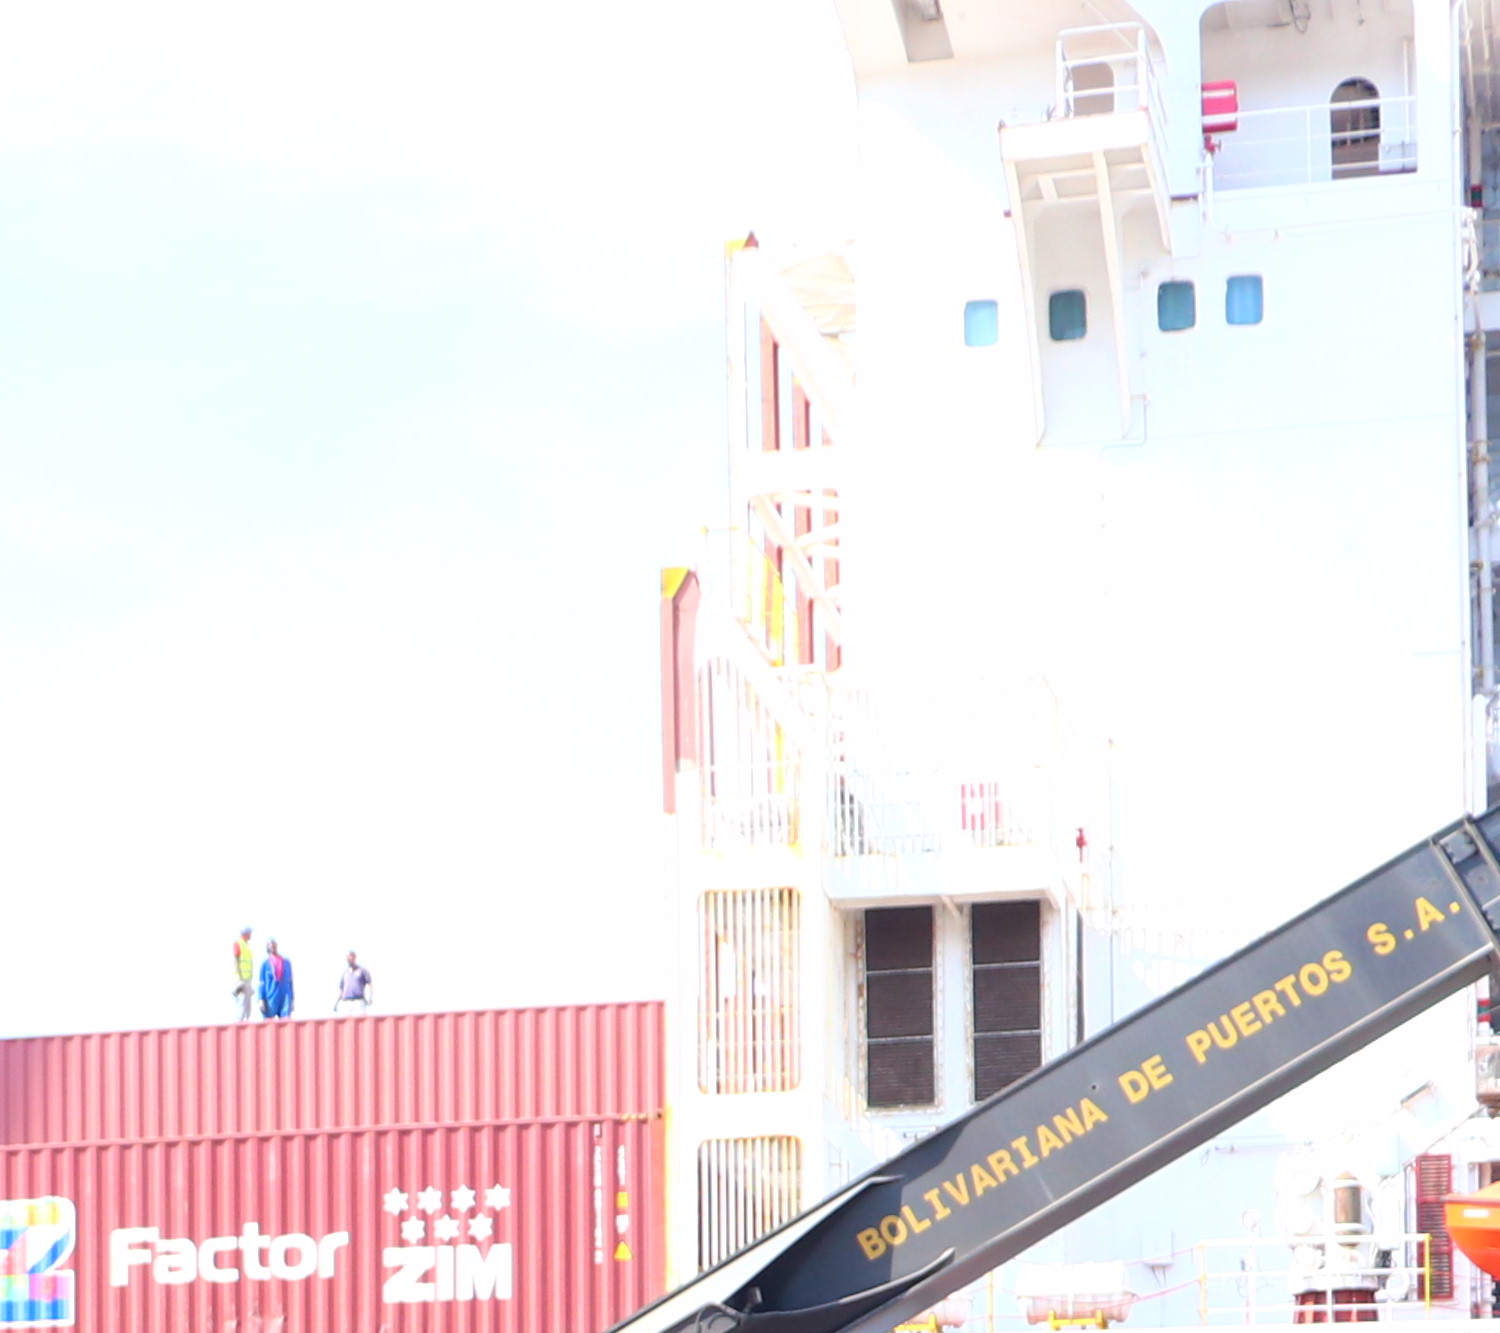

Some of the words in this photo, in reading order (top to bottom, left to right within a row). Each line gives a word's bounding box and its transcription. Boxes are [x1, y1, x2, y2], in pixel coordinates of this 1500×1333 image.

[856, 1097, 1109, 1261] BOLIVARIANA
[1117, 1054, 1174, 1104] DE
[1185, 950, 1353, 1065] PUERTOS
[1366, 896, 1461, 956] S.A.
[109, 1221, 351, 1288] Factor
[382, 1242, 512, 1304] ZIM
